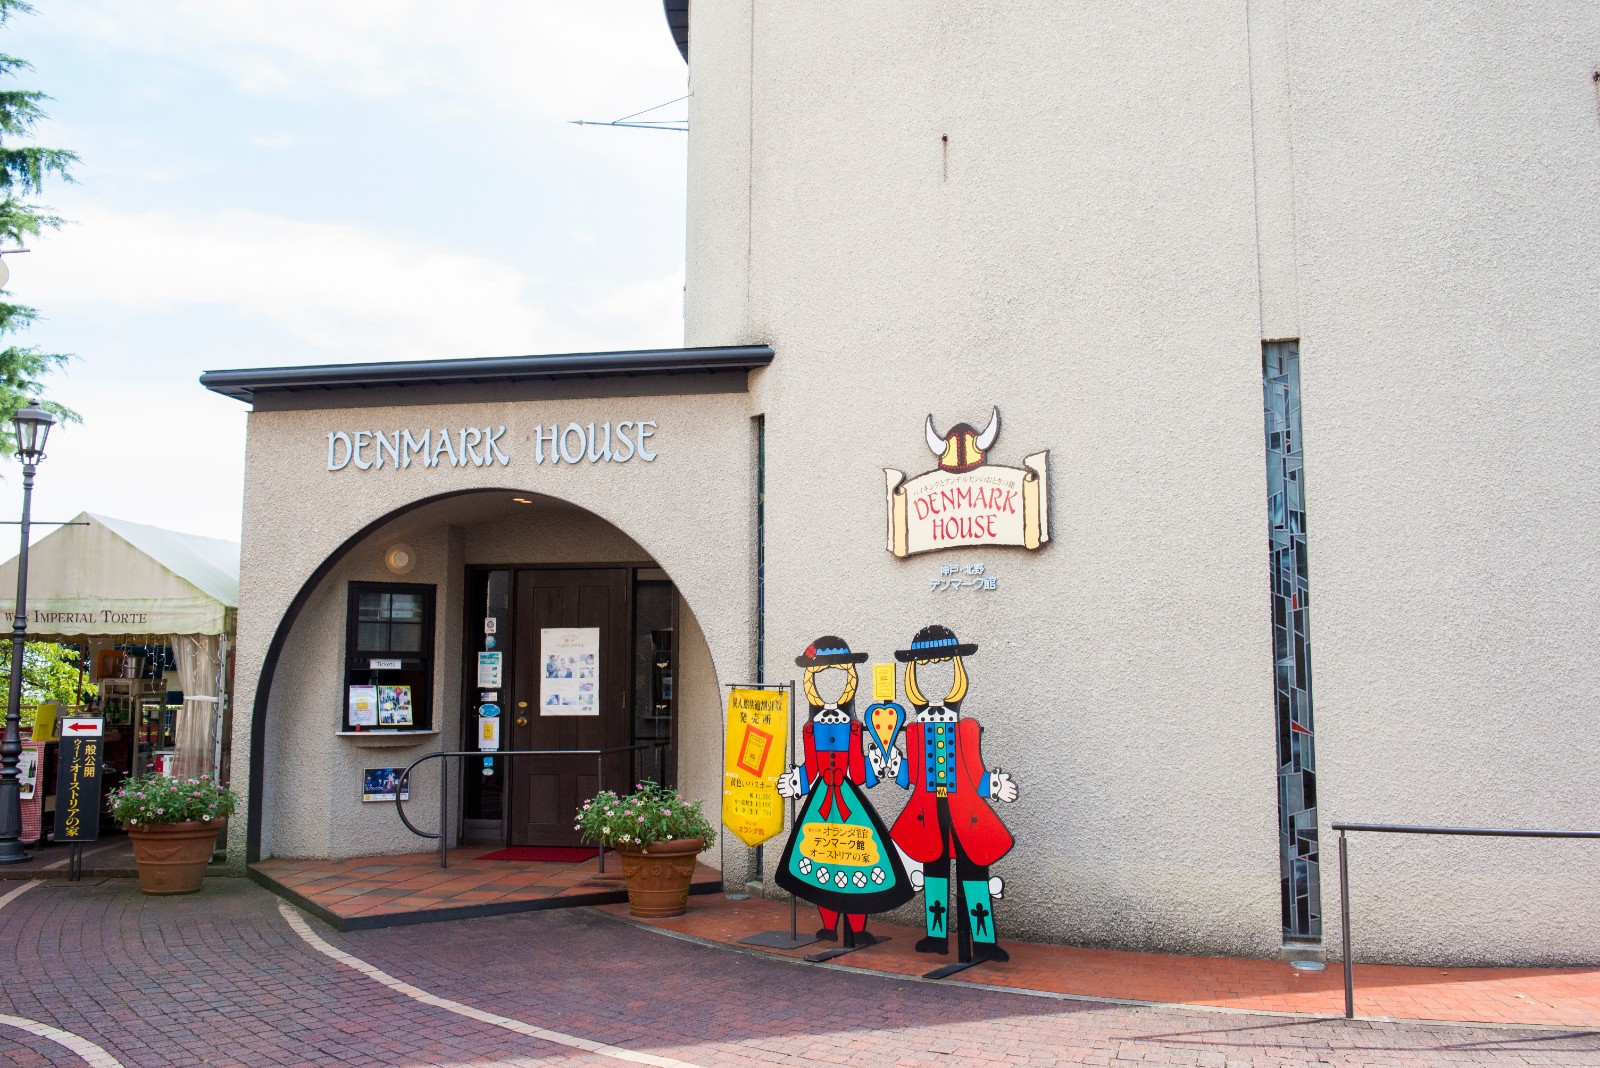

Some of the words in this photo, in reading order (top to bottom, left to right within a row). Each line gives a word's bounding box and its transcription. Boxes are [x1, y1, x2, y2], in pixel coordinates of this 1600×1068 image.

[326, 425, 510, 471] DENMARK
[534, 420, 658, 465] HOUSE
[913, 486, 1018, 520] DENMARK
[932, 514, 998, 540] HOUSE
[34, 610, 97, 624] IMPERIAL
[101, 610, 147, 624] TORTE
[740, 711, 772, 725] 発売所
[83, 739, 97, 778] 一般公開
[65, 738, 82, 837] ウィーンオーストリアの家
[823, 826, 869, 839] オランダ館
[810, 848, 870, 863] オーストリアの家
